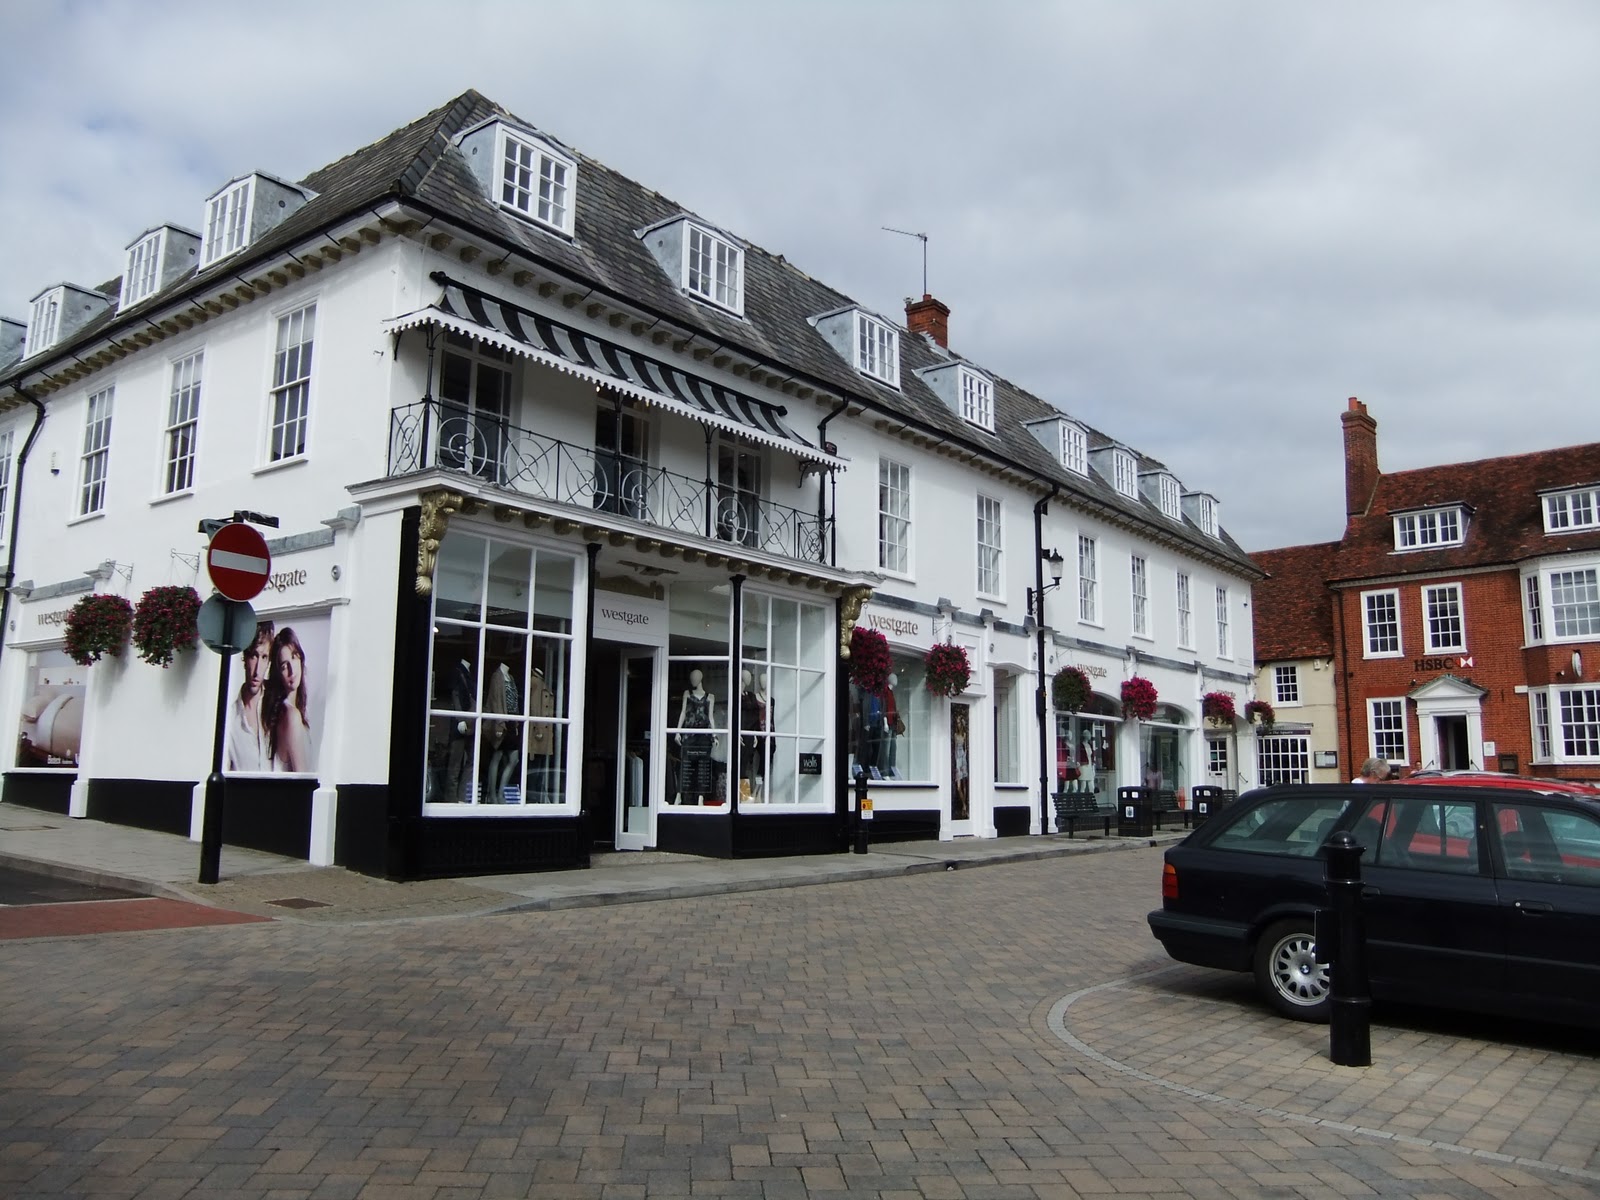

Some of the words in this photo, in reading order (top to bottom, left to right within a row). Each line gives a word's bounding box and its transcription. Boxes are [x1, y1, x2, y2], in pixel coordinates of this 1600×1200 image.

[264, 569, 307, 593] stgate
[601, 608, 649, 625] westgate
[868, 614, 918, 636] westgate
[1414, 657, 1453, 671] HSBC
